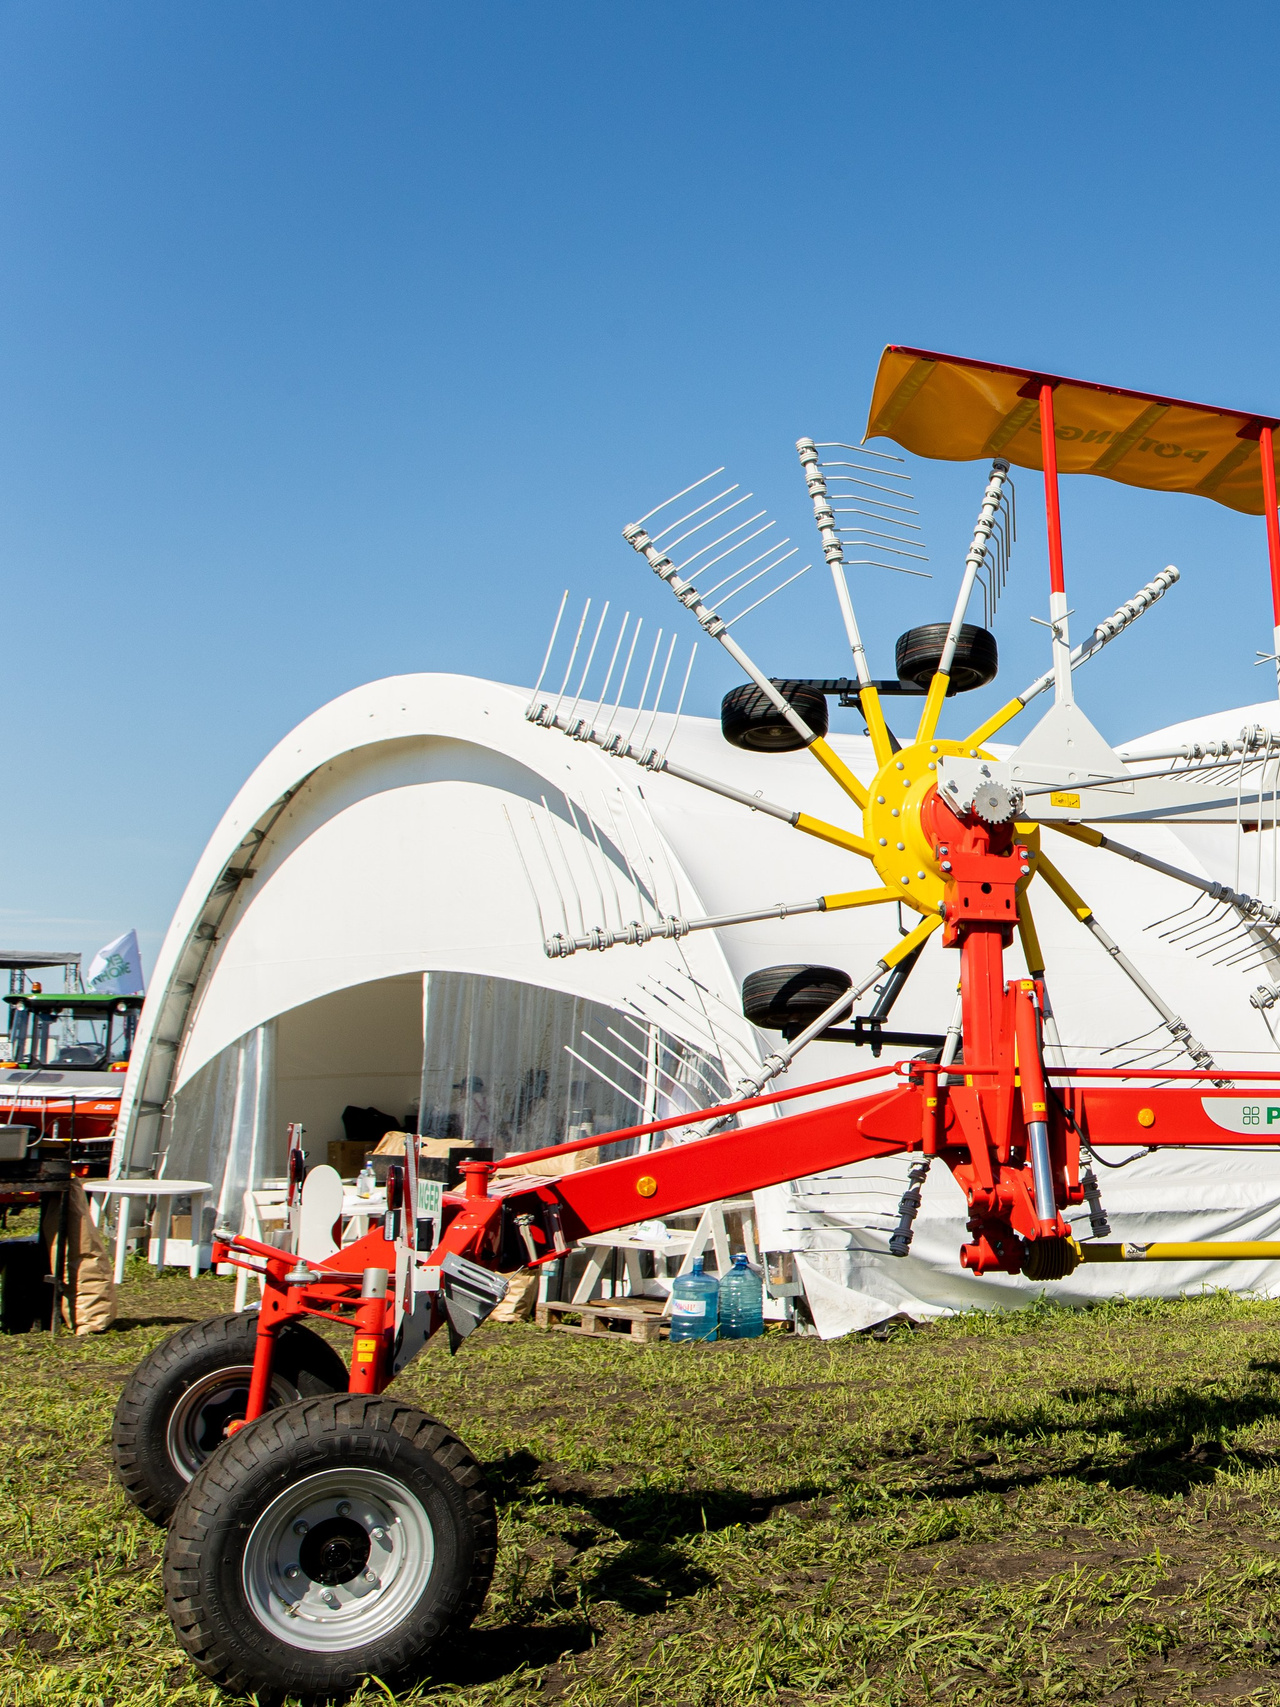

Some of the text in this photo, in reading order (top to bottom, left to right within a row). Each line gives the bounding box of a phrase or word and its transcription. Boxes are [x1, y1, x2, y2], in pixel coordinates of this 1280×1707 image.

[93, 1103, 115, 1111] EMC
[418, 1183, 440, 1212] NGER
[213, 1434, 401, 1534] VREDESTEIN
